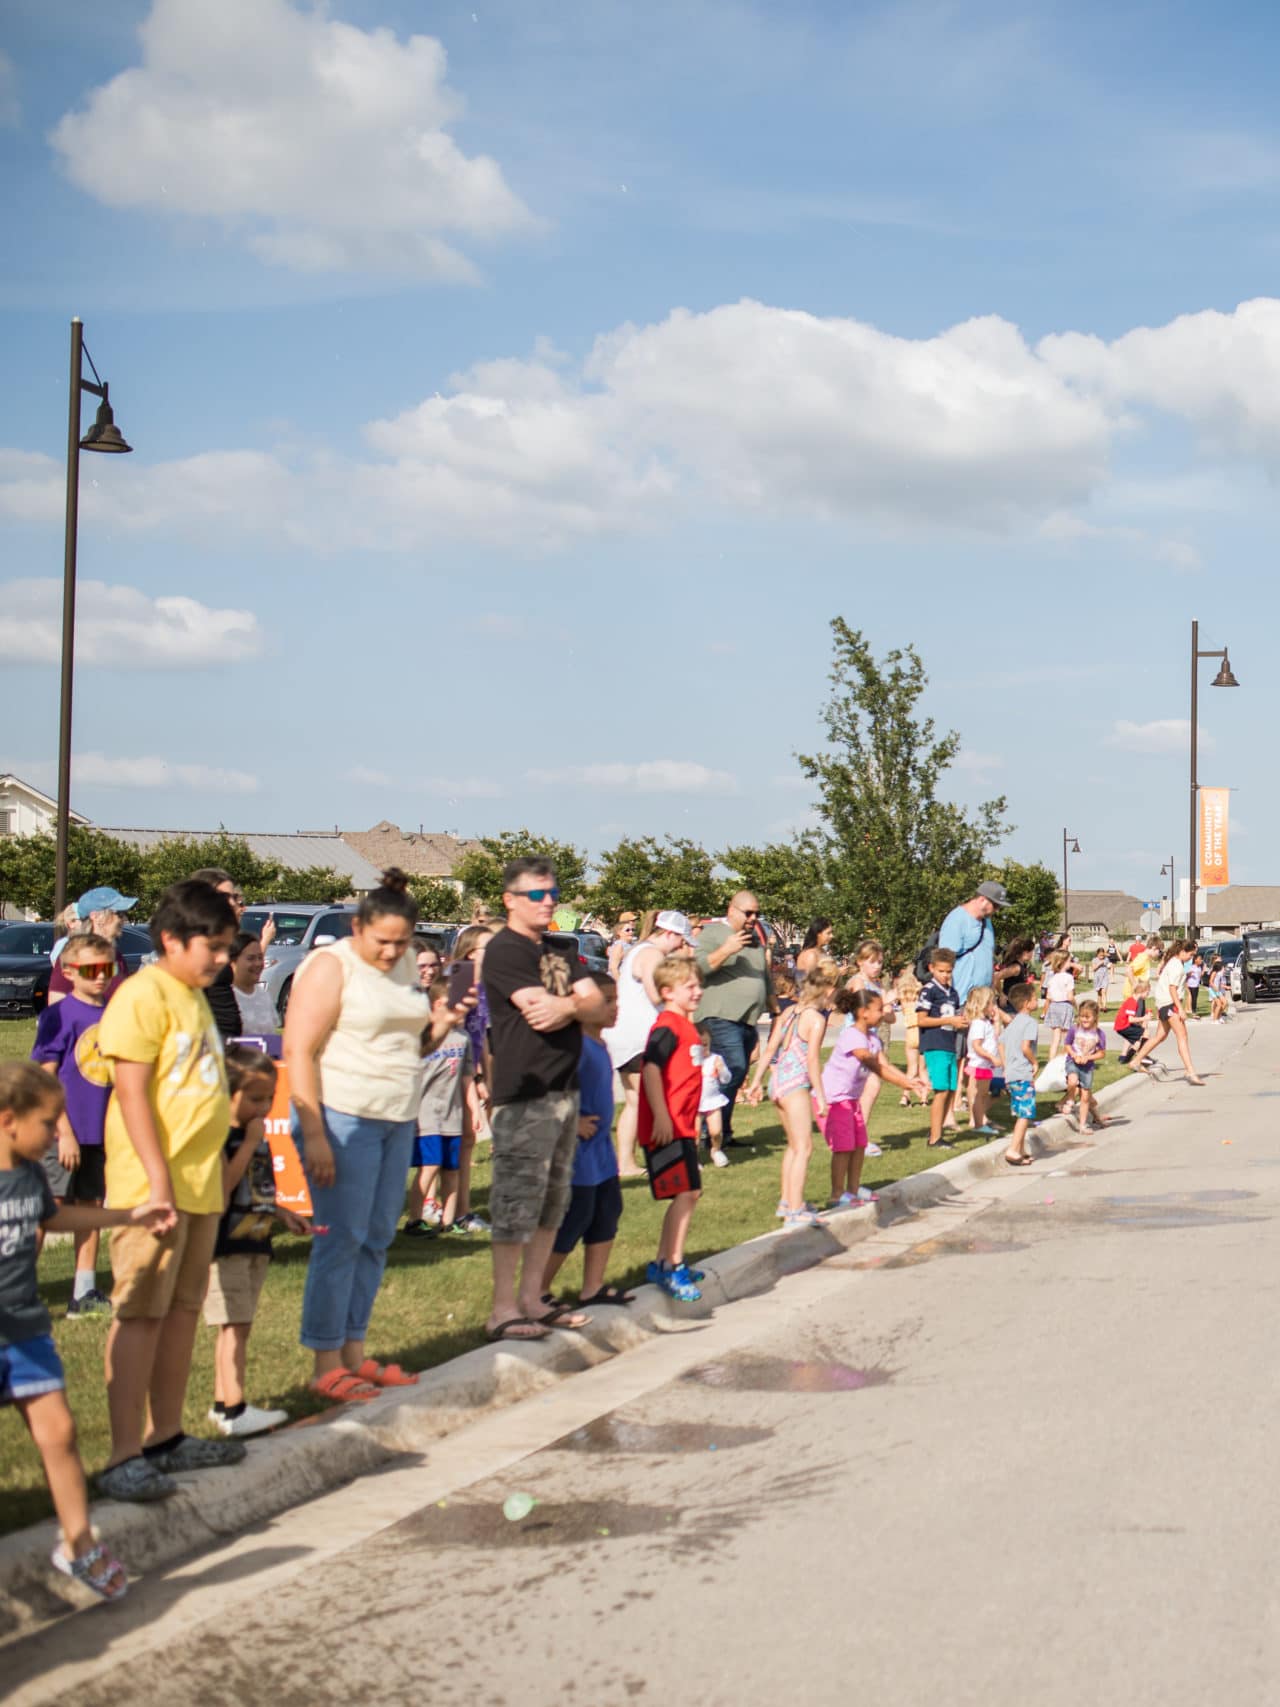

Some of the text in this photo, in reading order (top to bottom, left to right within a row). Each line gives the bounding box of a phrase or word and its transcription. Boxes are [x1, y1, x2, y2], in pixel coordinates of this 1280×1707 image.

[1204, 806, 1212, 866] COMMUNITY
[1214, 805, 1222, 866] OF THE YEAR
